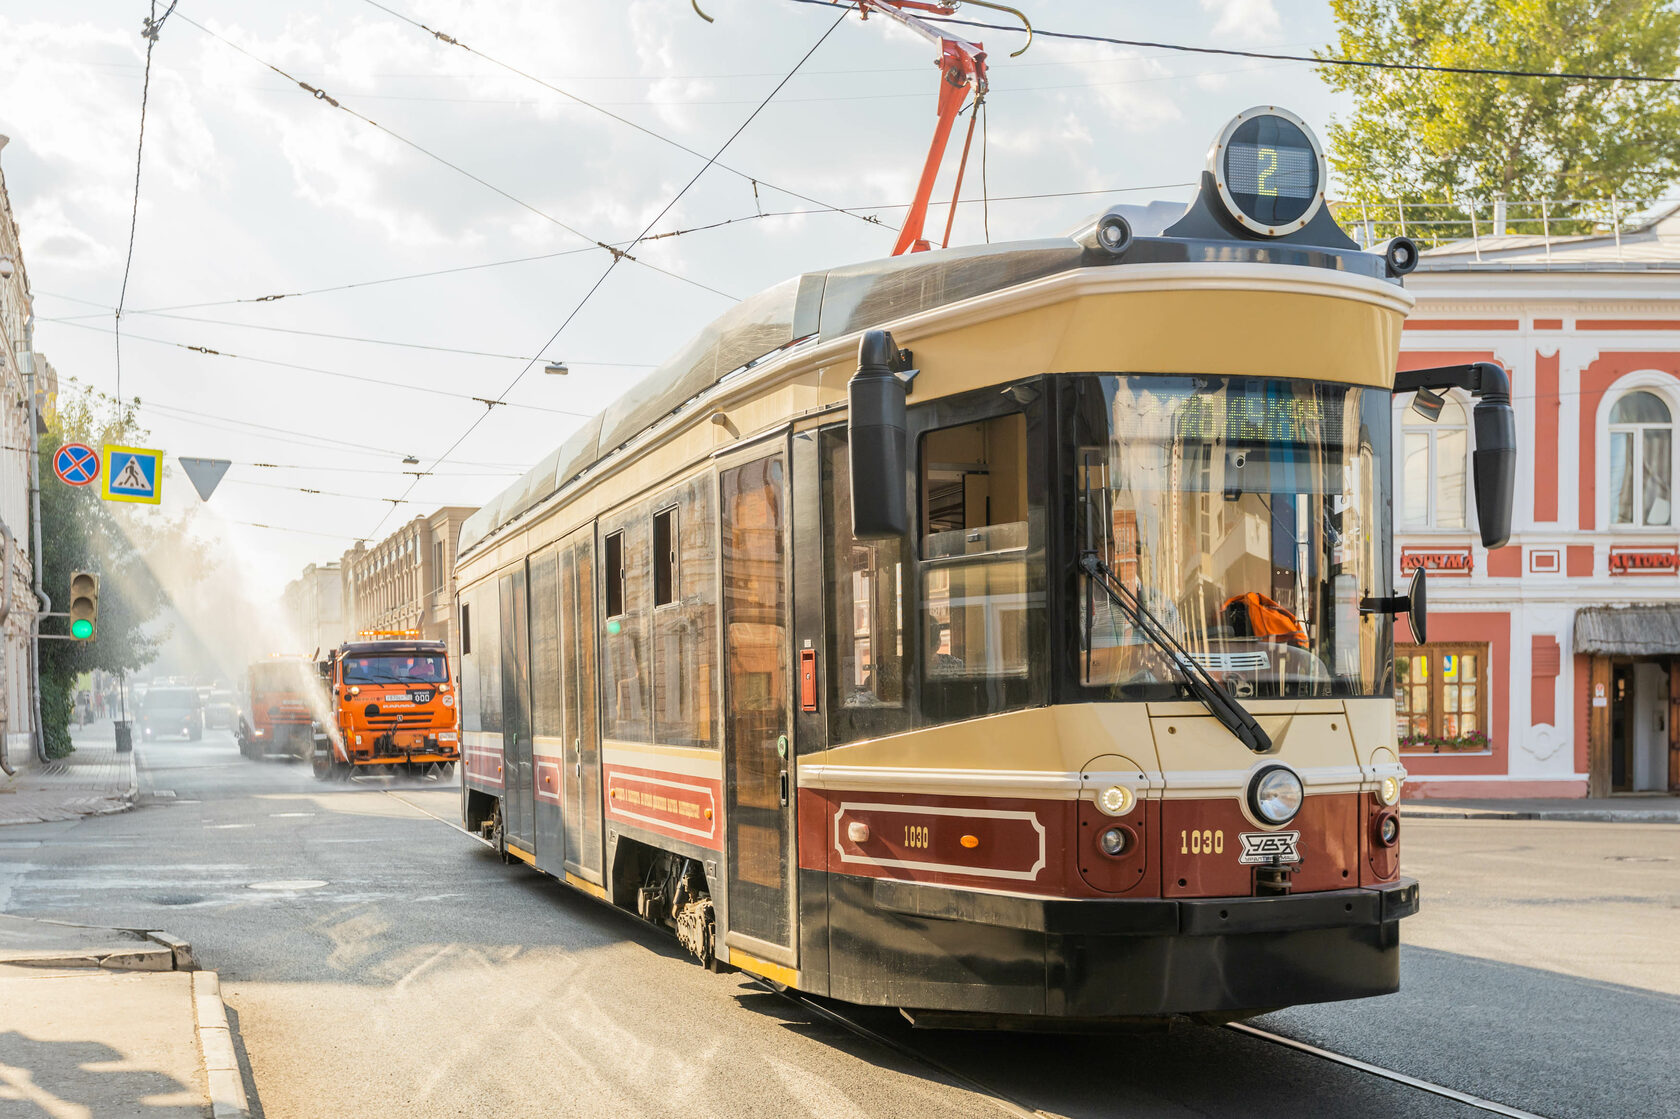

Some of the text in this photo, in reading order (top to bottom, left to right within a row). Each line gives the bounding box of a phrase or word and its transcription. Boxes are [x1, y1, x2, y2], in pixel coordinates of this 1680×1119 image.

[1258, 148, 1277, 196] 2
[1400, 554, 1474, 569] КОРЧМА
[904, 825, 929, 848] 1030
[1181, 829, 1224, 855] 1030
[1246, 834, 1295, 857] УВЗ
